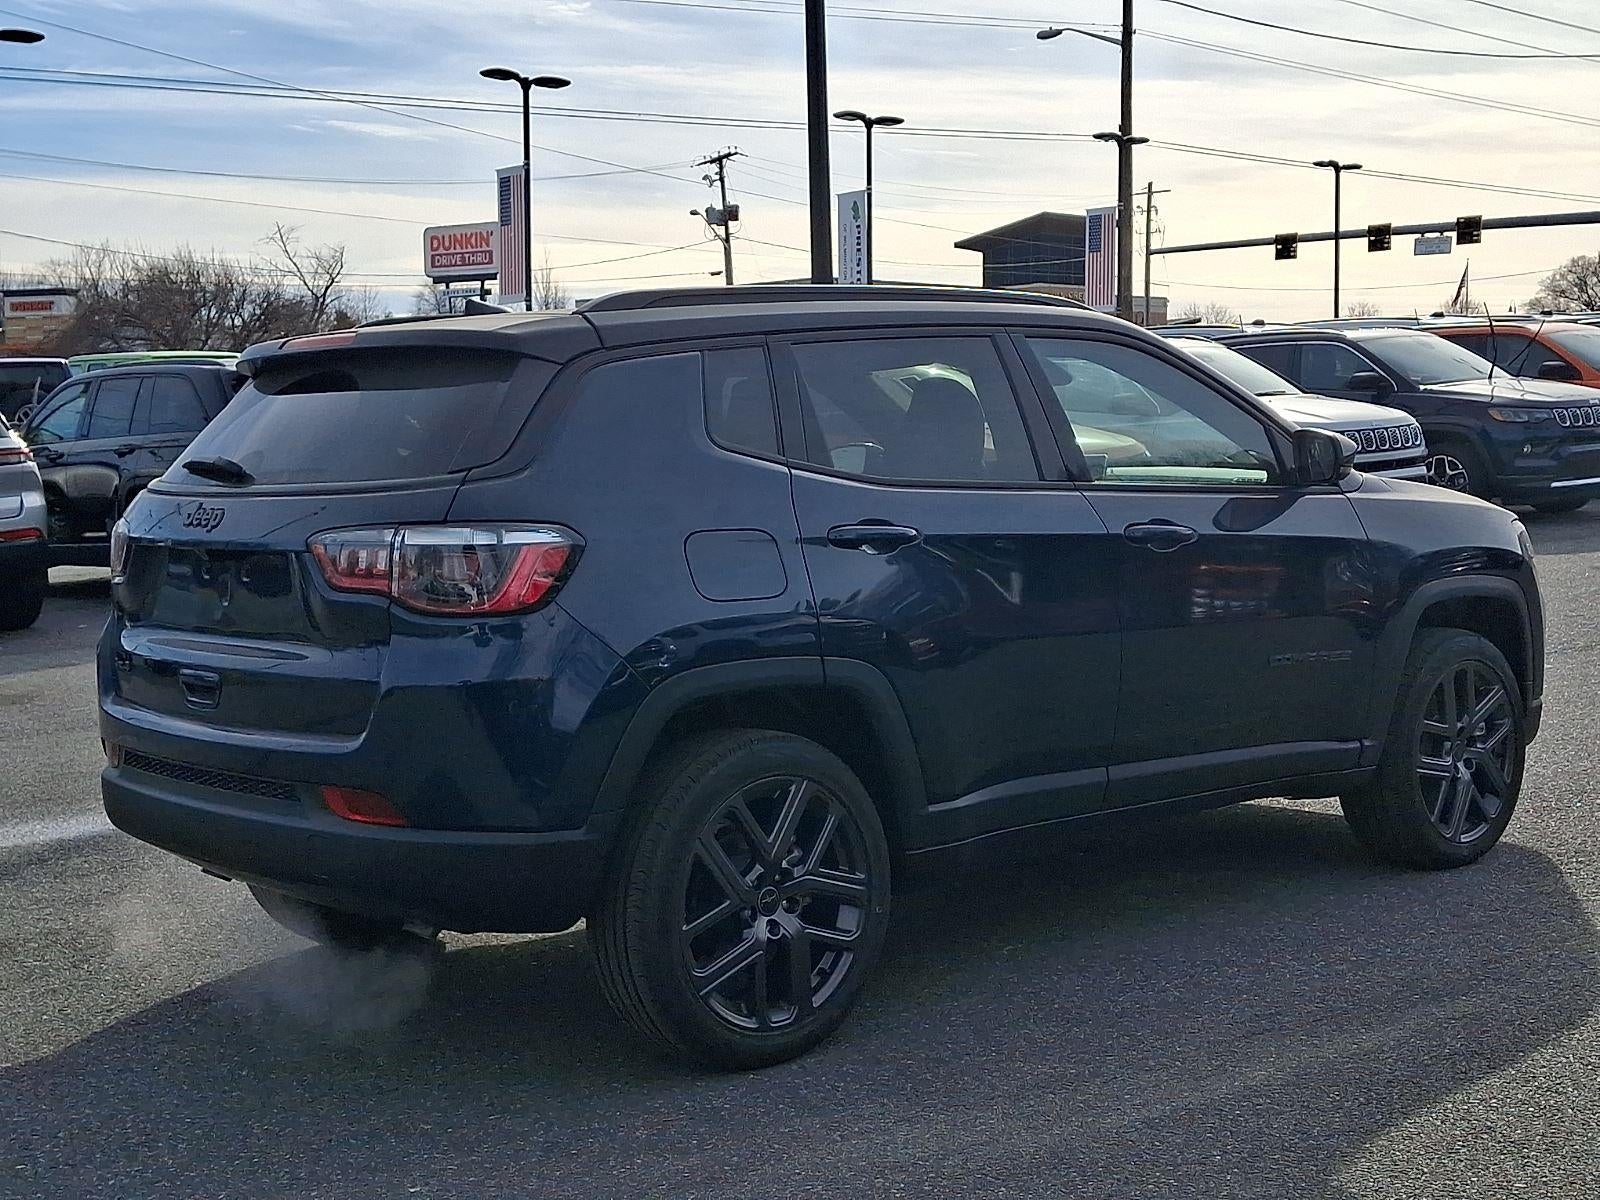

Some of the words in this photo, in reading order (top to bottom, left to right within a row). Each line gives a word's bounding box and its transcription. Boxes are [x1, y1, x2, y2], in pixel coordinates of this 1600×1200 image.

[430, 230, 494, 252] DUNKIN'
[435, 254, 463, 267] DRIVE
[464, 252, 490, 264] THRU
[182, 502, 226, 533] Jeep
